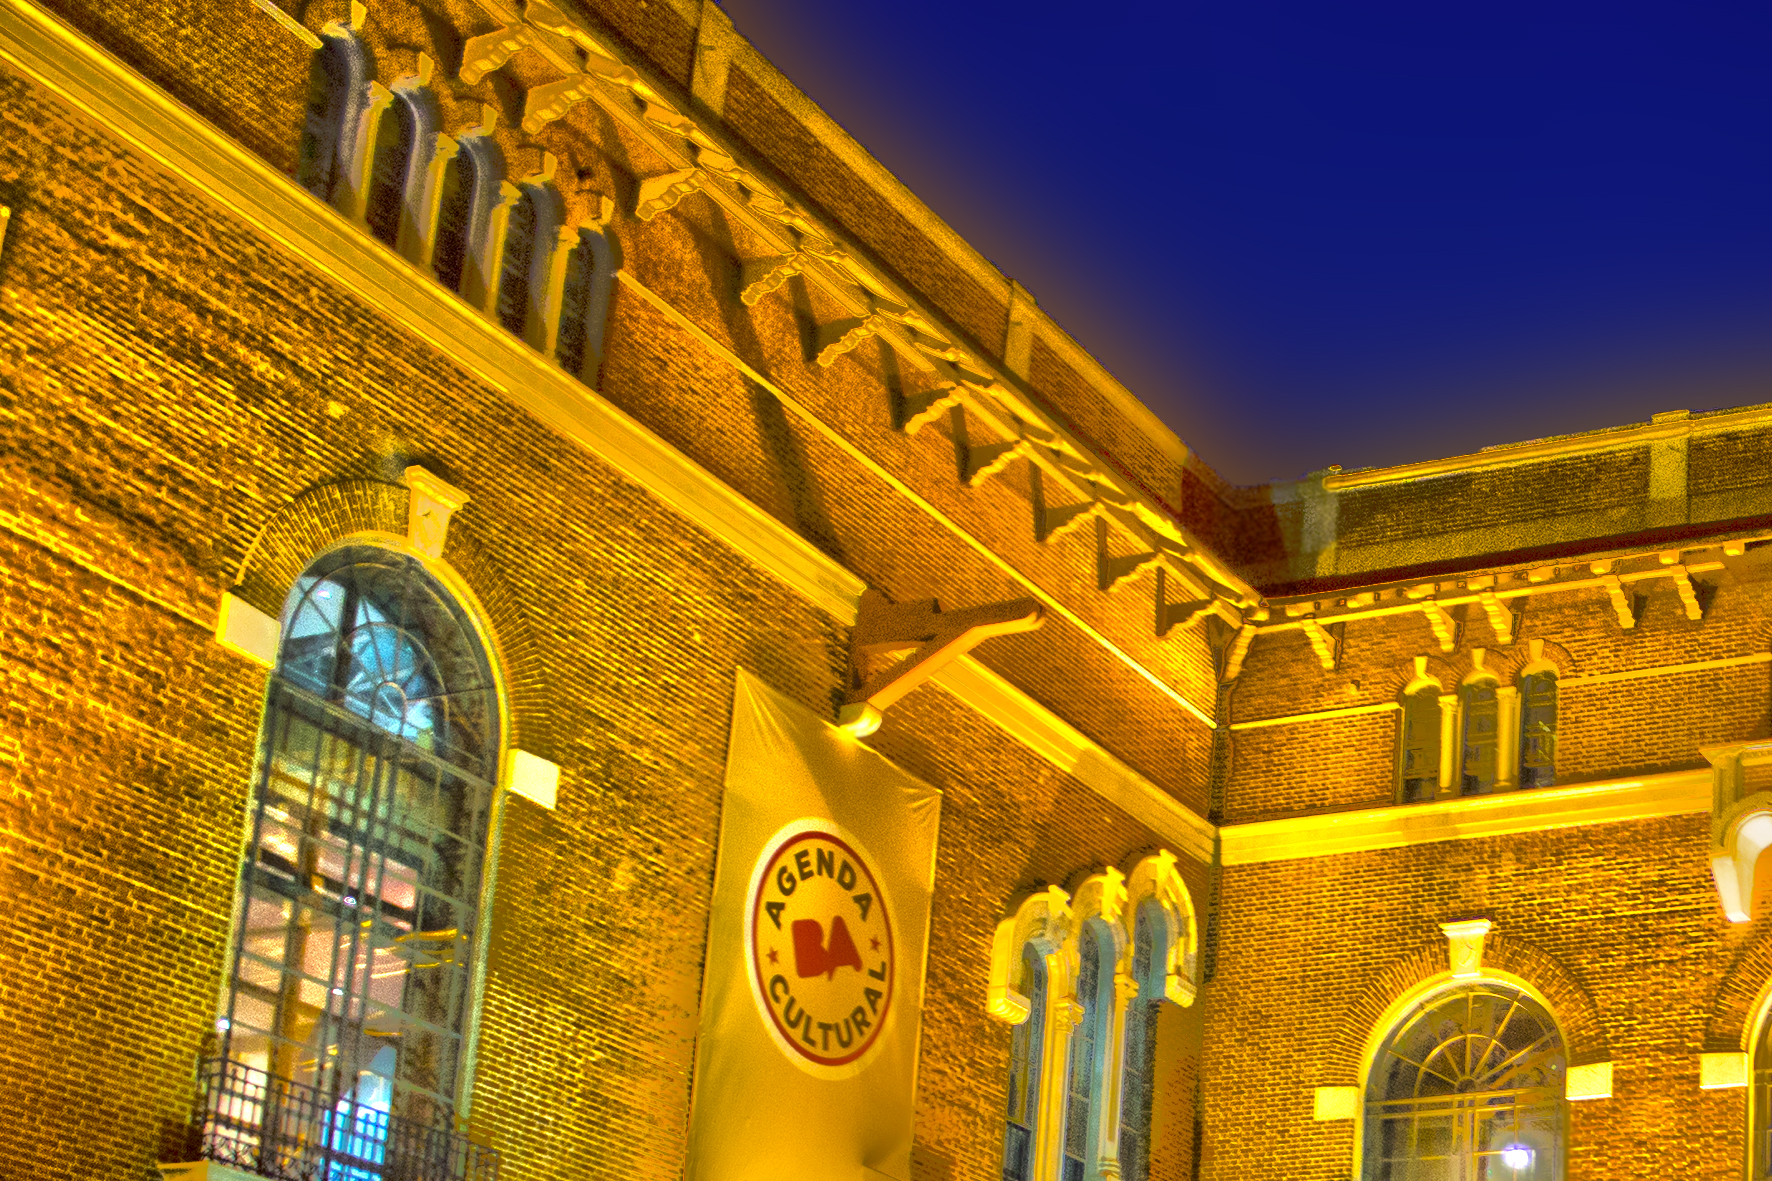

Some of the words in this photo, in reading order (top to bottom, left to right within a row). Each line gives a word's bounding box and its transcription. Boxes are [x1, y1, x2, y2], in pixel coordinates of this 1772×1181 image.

[765, 848, 873, 930] AGENDA
[791, 915, 863, 982] BA
[769, 961, 887, 1051] CULTURAL
